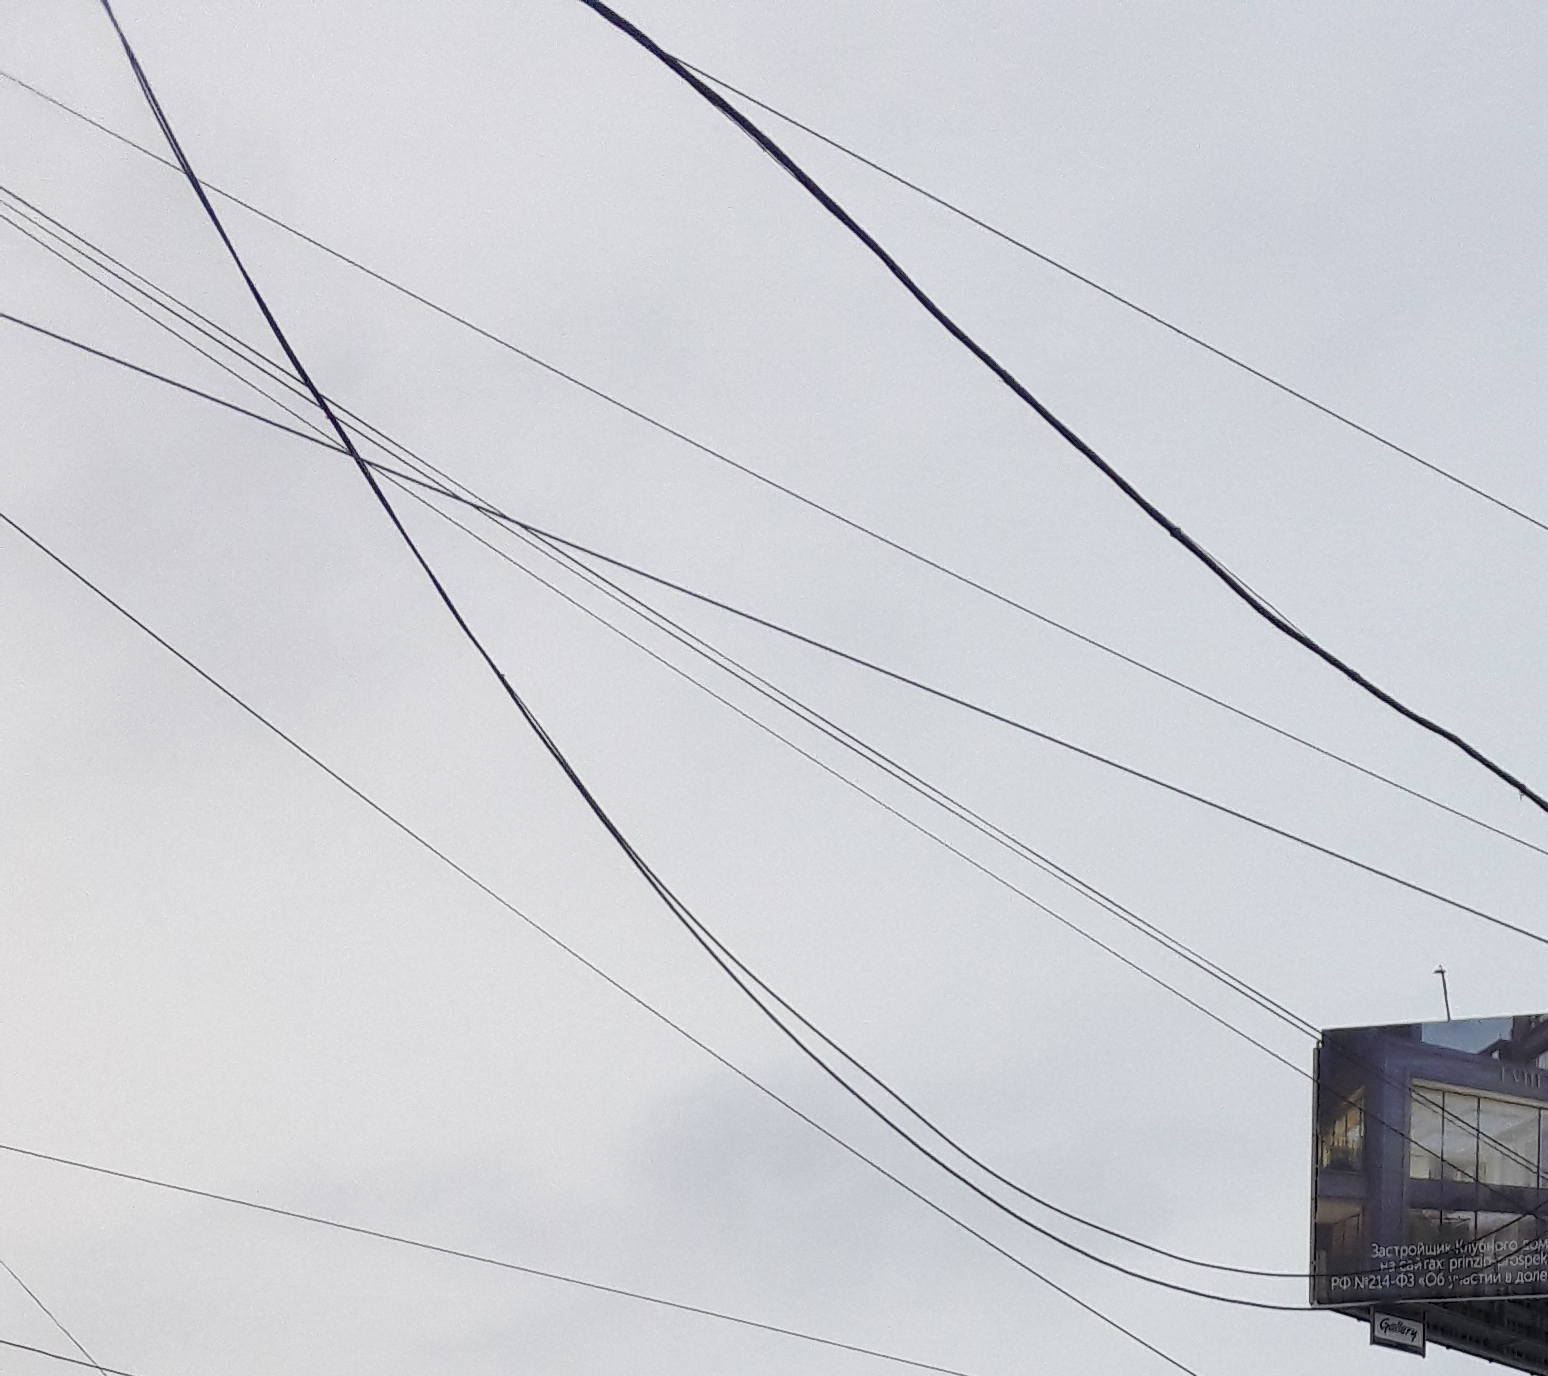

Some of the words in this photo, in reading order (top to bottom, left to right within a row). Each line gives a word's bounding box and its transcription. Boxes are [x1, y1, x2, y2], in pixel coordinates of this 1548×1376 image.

[1371, 1242, 1452, 1258] Застройщик
[1455, 1238, 1518, 1256] Клубного
[1331, 1276, 1351, 1291] РФ
